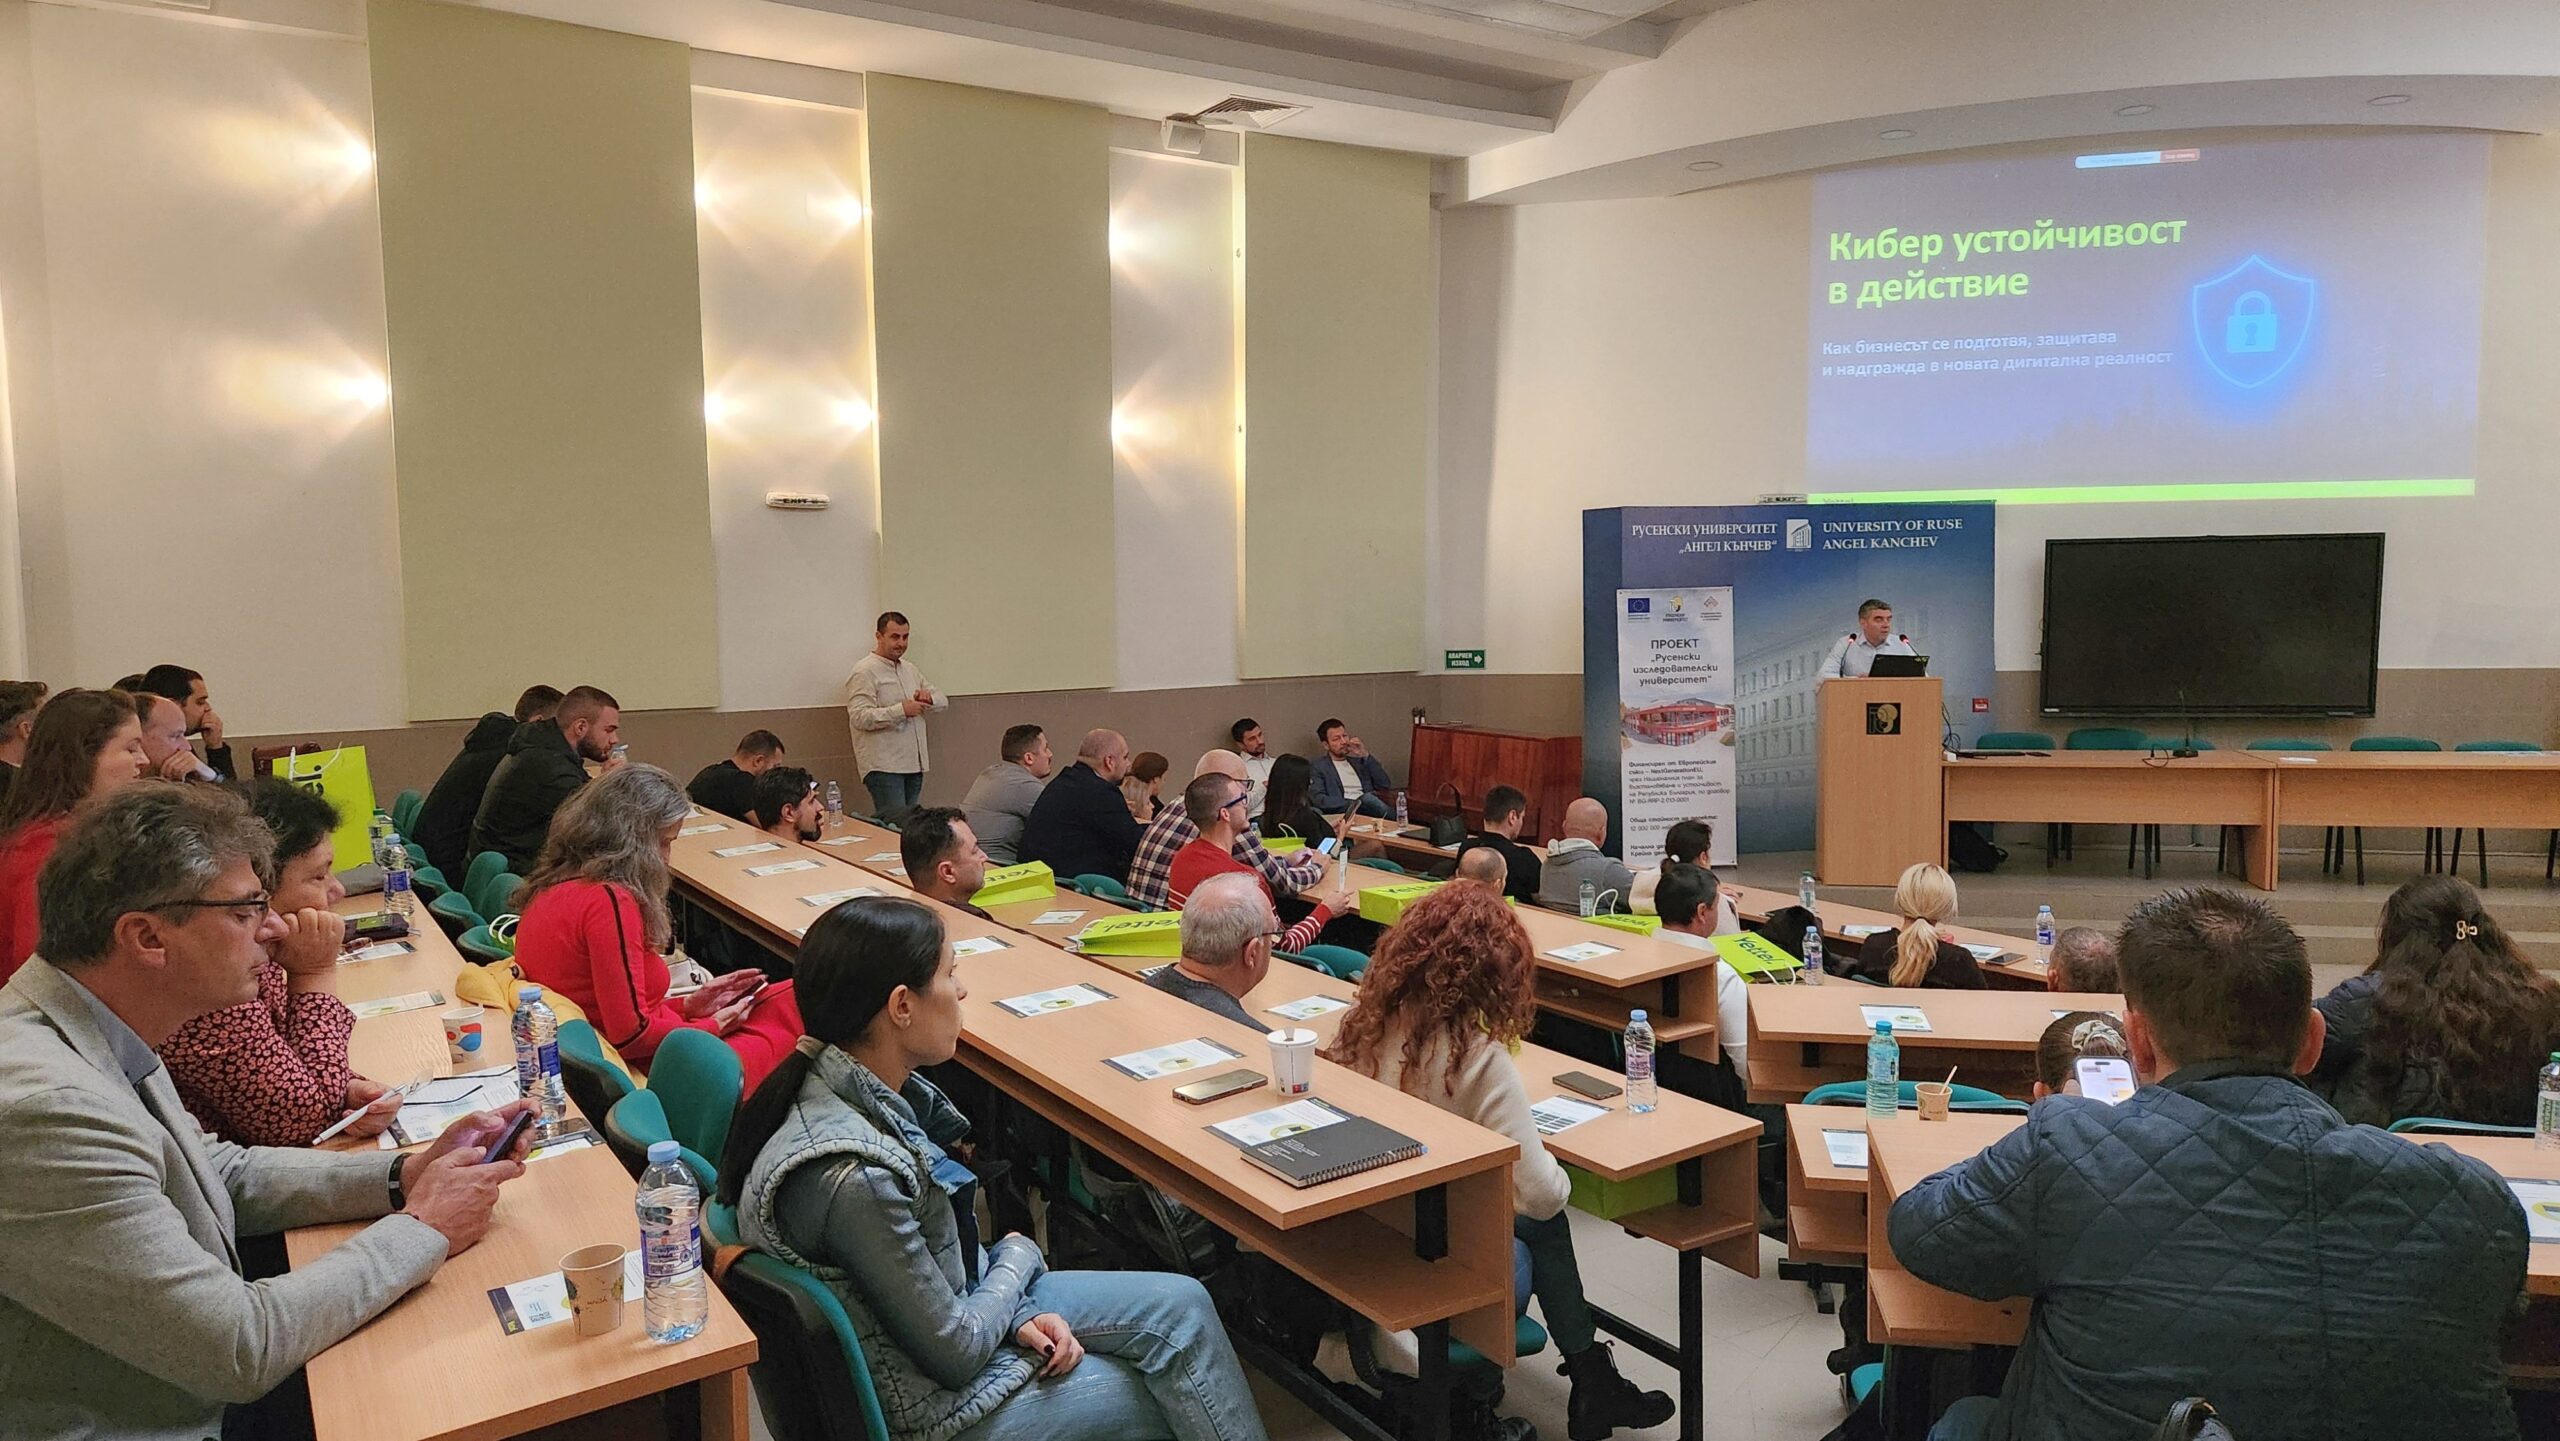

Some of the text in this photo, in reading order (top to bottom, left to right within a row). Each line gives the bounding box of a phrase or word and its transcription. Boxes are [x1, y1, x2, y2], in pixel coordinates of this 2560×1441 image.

[1829, 219, 2187, 263] Кибер устойчивост
[1828, 270, 2029, 308] в действие
[1823, 331, 2117, 355] Как бизнесът се подготвя, защитава
[1822, 350, 2173, 378] и надгражда в новата дигитална реалност
[1632, 523, 1778, 537] РУСЕНСКИ УНИВЕРСИТЕТ
[1823, 518, 1963, 533] UNIVERSITY OF RUSE
[1823, 536, 1938, 550] ANGEL KANCHEV
[1651, 639, 1699, 649] ПРОЕКТ
[1633, 664, 1718, 674] изследователски
